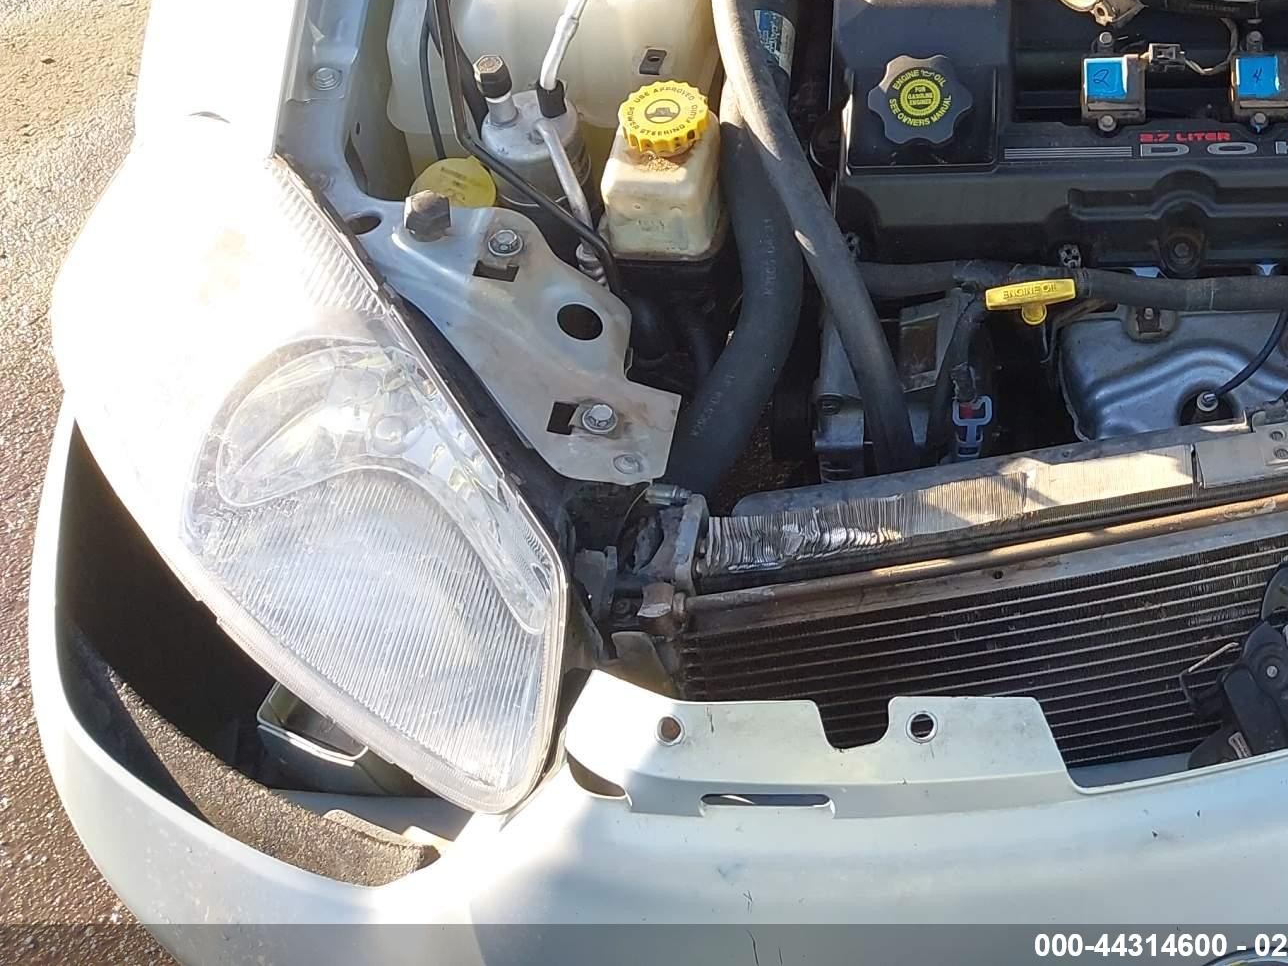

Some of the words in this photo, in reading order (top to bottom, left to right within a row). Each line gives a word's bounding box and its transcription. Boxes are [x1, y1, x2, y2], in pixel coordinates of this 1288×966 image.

[892, 69, 920, 90] ENGINE
[934, 73, 947, 88] OIL
[1093, 69, 1109, 85] 2
[1253, 67, 1263, 82] 4
[634, 92, 650, 103] USE
[653, 86, 696, 101] APPROVED
[889, 98, 900, 114] SEE
[930, 94, 952, 123] MANUAL
[640, 124, 686, 137] STEERING
[1140, 133, 1170, 142] 2.7
[1176, 131, 1231, 141] LITER
[1003, 286, 1040, 300] ENGINE
[1040, 282, 1056, 293] OIL
